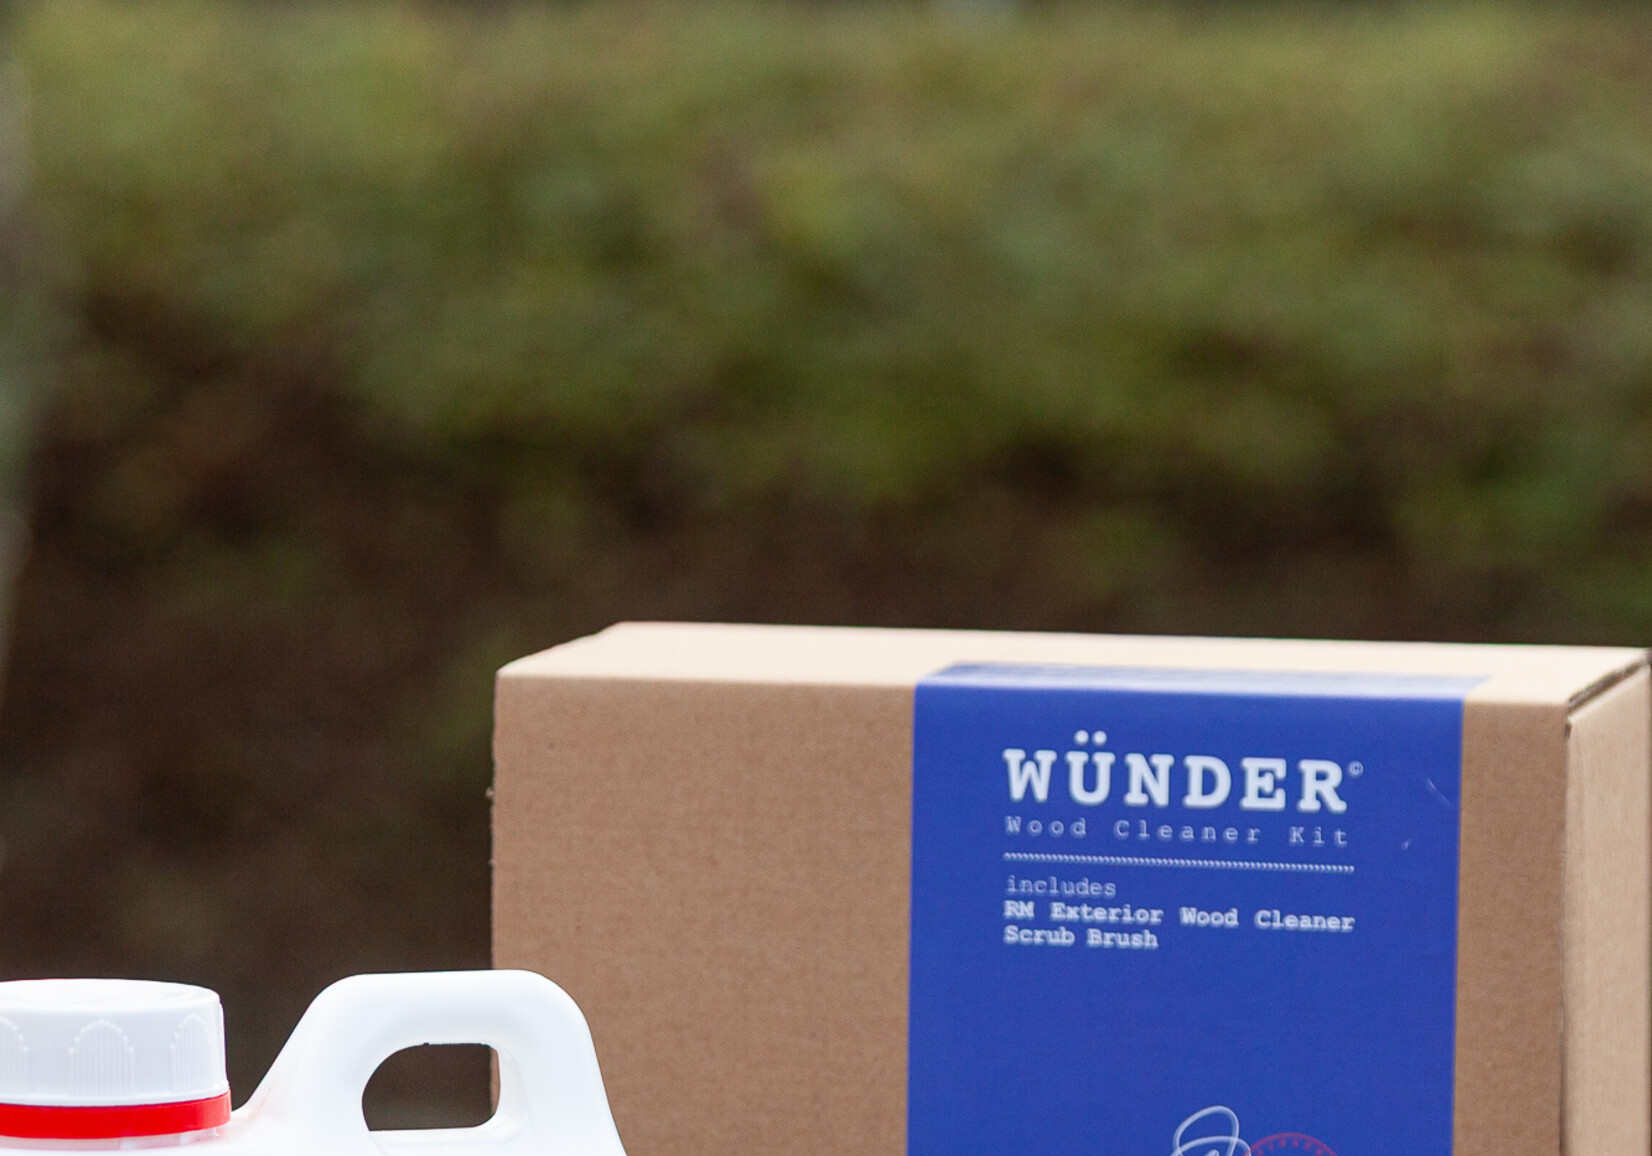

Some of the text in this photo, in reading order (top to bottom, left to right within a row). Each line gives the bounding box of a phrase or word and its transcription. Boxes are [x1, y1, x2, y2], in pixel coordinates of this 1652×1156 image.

[1003, 730, 1348, 814] WÜNDER
[1005, 815, 1347, 847] Wood Cleaner Kit
[1006, 875, 1117, 899] includes
[1003, 900, 1356, 933] RM Exterior Wood Cleaner
[1003, 924, 1160, 950] Scrub Brush
